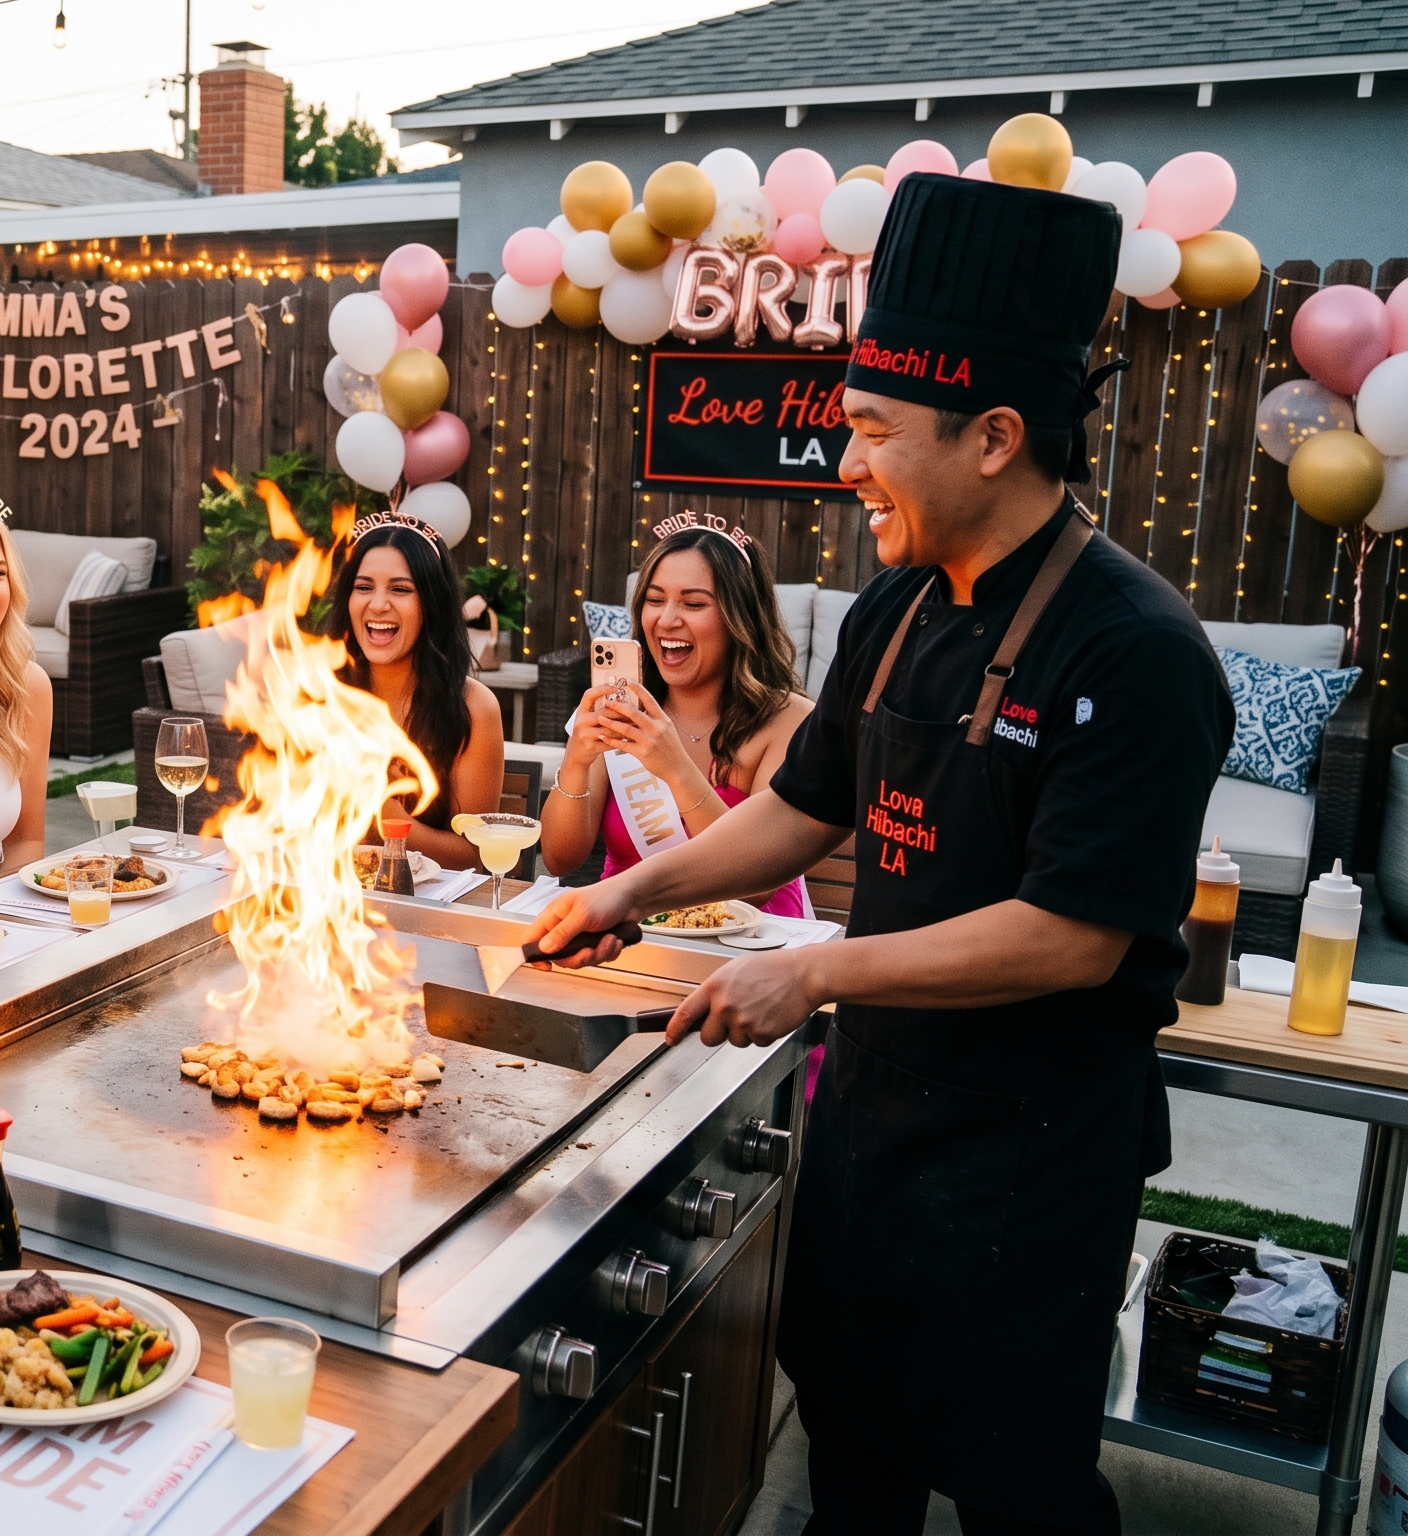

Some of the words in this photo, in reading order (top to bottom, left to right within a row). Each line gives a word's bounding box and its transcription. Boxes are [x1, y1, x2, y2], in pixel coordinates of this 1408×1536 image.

[935, 353, 970, 388] LA
[668, 377, 766, 427] Love
[776, 379, 852, 429] Hib
[779, 436, 827, 466] LA
[704, 513, 727, 531] TO
[1001, 696, 1038, 724] Love
[879, 842, 906, 877] LA
